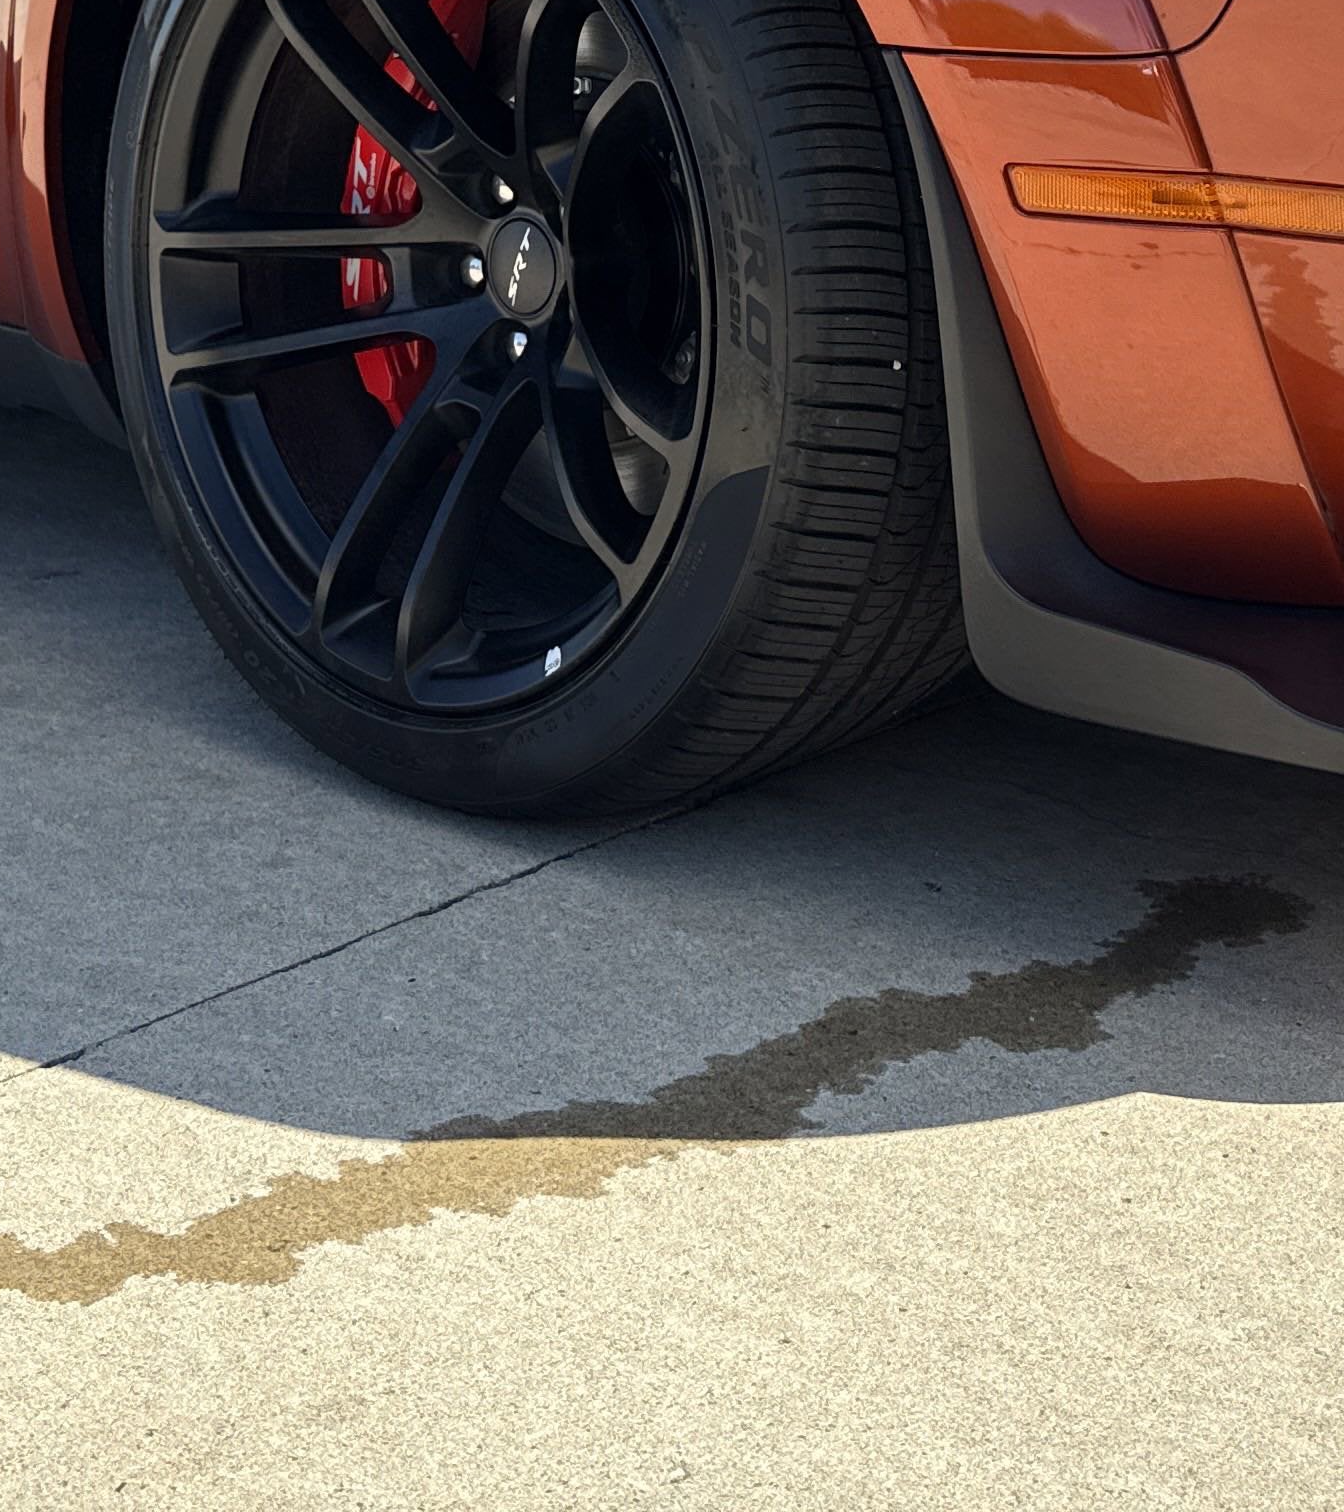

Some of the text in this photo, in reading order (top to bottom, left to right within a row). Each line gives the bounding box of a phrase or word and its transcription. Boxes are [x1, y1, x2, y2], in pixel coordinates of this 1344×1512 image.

[507, 226, 531, 307] SRT
[704, 140, 742, 349] ALL SEASON
[710, 97, 773, 367] ZERO
